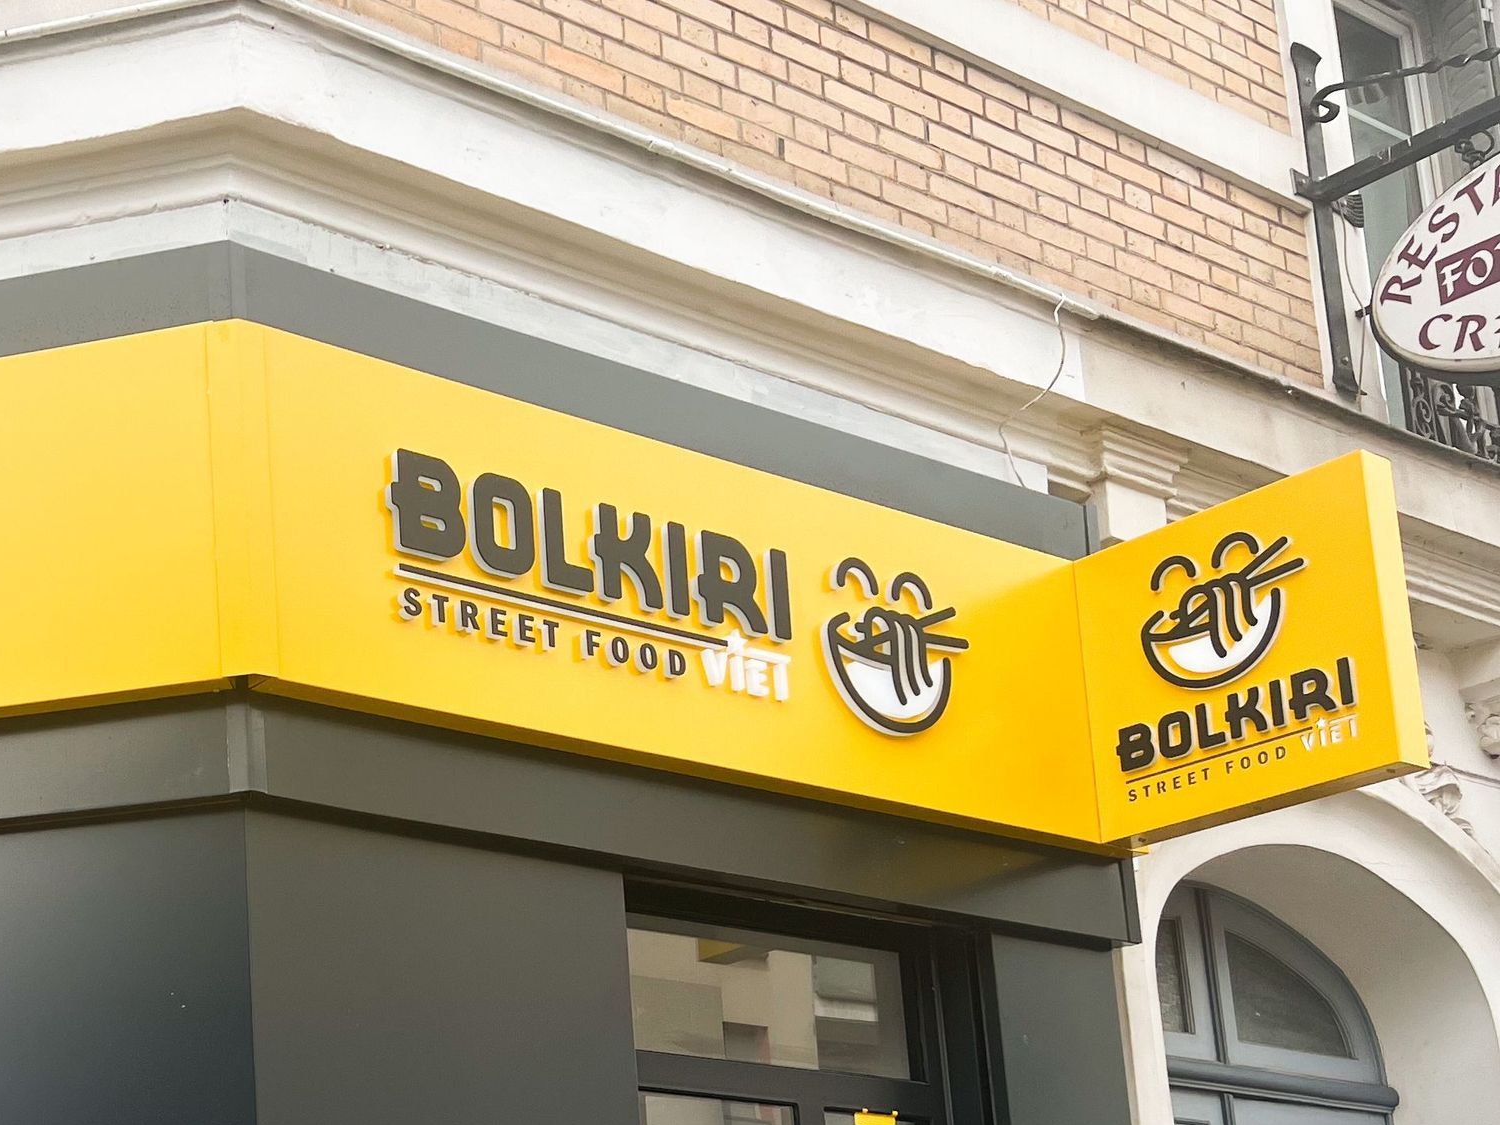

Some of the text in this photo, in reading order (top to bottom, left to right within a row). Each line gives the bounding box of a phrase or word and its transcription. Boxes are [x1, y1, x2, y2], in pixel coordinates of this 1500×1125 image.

[1439, 244, 1500, 298] FO
[1418, 314, 1500, 352] CR
[387, 448, 792, 643] BOLKIRI
[401, 587, 559, 650] STREET
[583, 631, 687, 679] FOOD
[1116, 656, 1356, 772] BOLKIRI
[1128, 768, 1211, 802] STREET
[1225, 747, 1287, 775] FOOD
